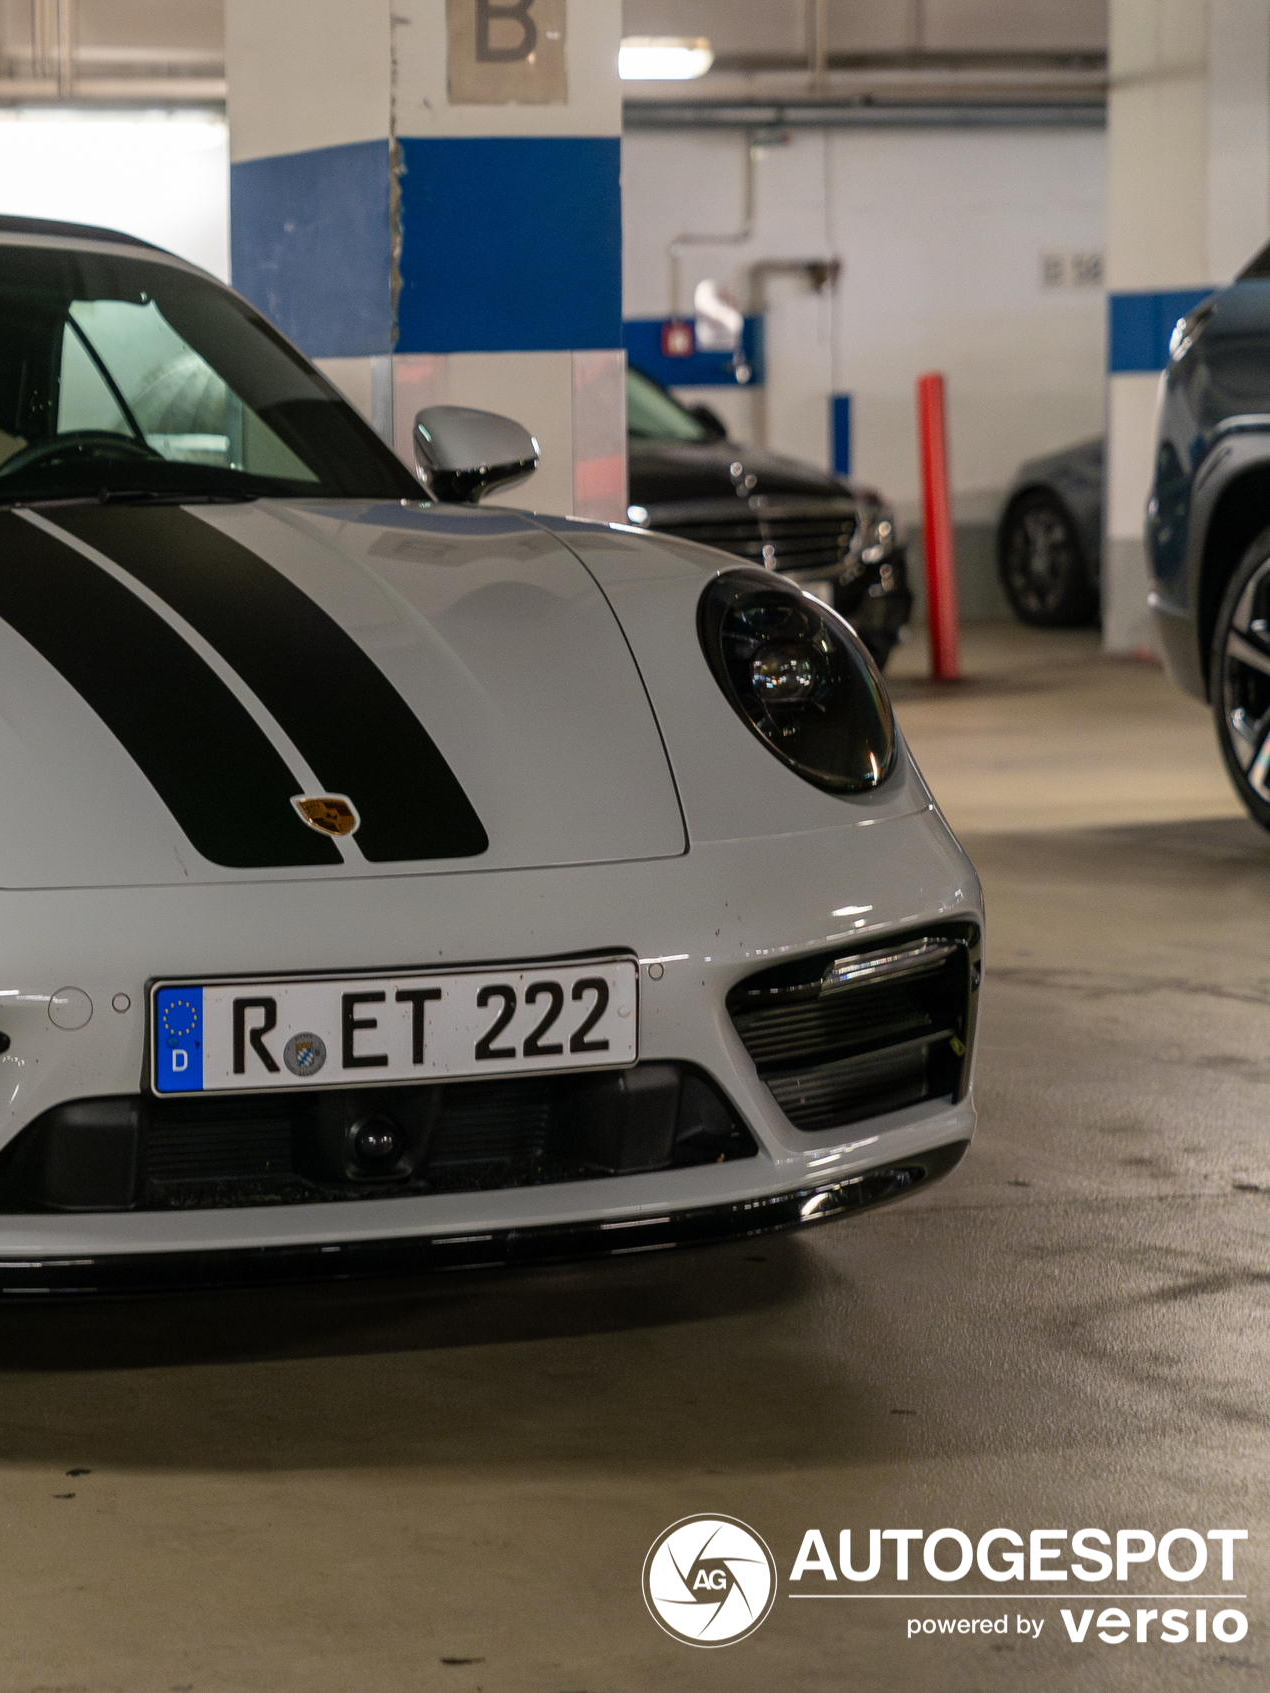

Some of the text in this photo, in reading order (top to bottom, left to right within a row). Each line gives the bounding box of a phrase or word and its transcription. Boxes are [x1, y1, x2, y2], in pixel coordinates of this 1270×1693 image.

[475, 0, 537, 62] B
[232, 977, 611, 1075] R ET 222
[172, 1049, 188, 1072] D
